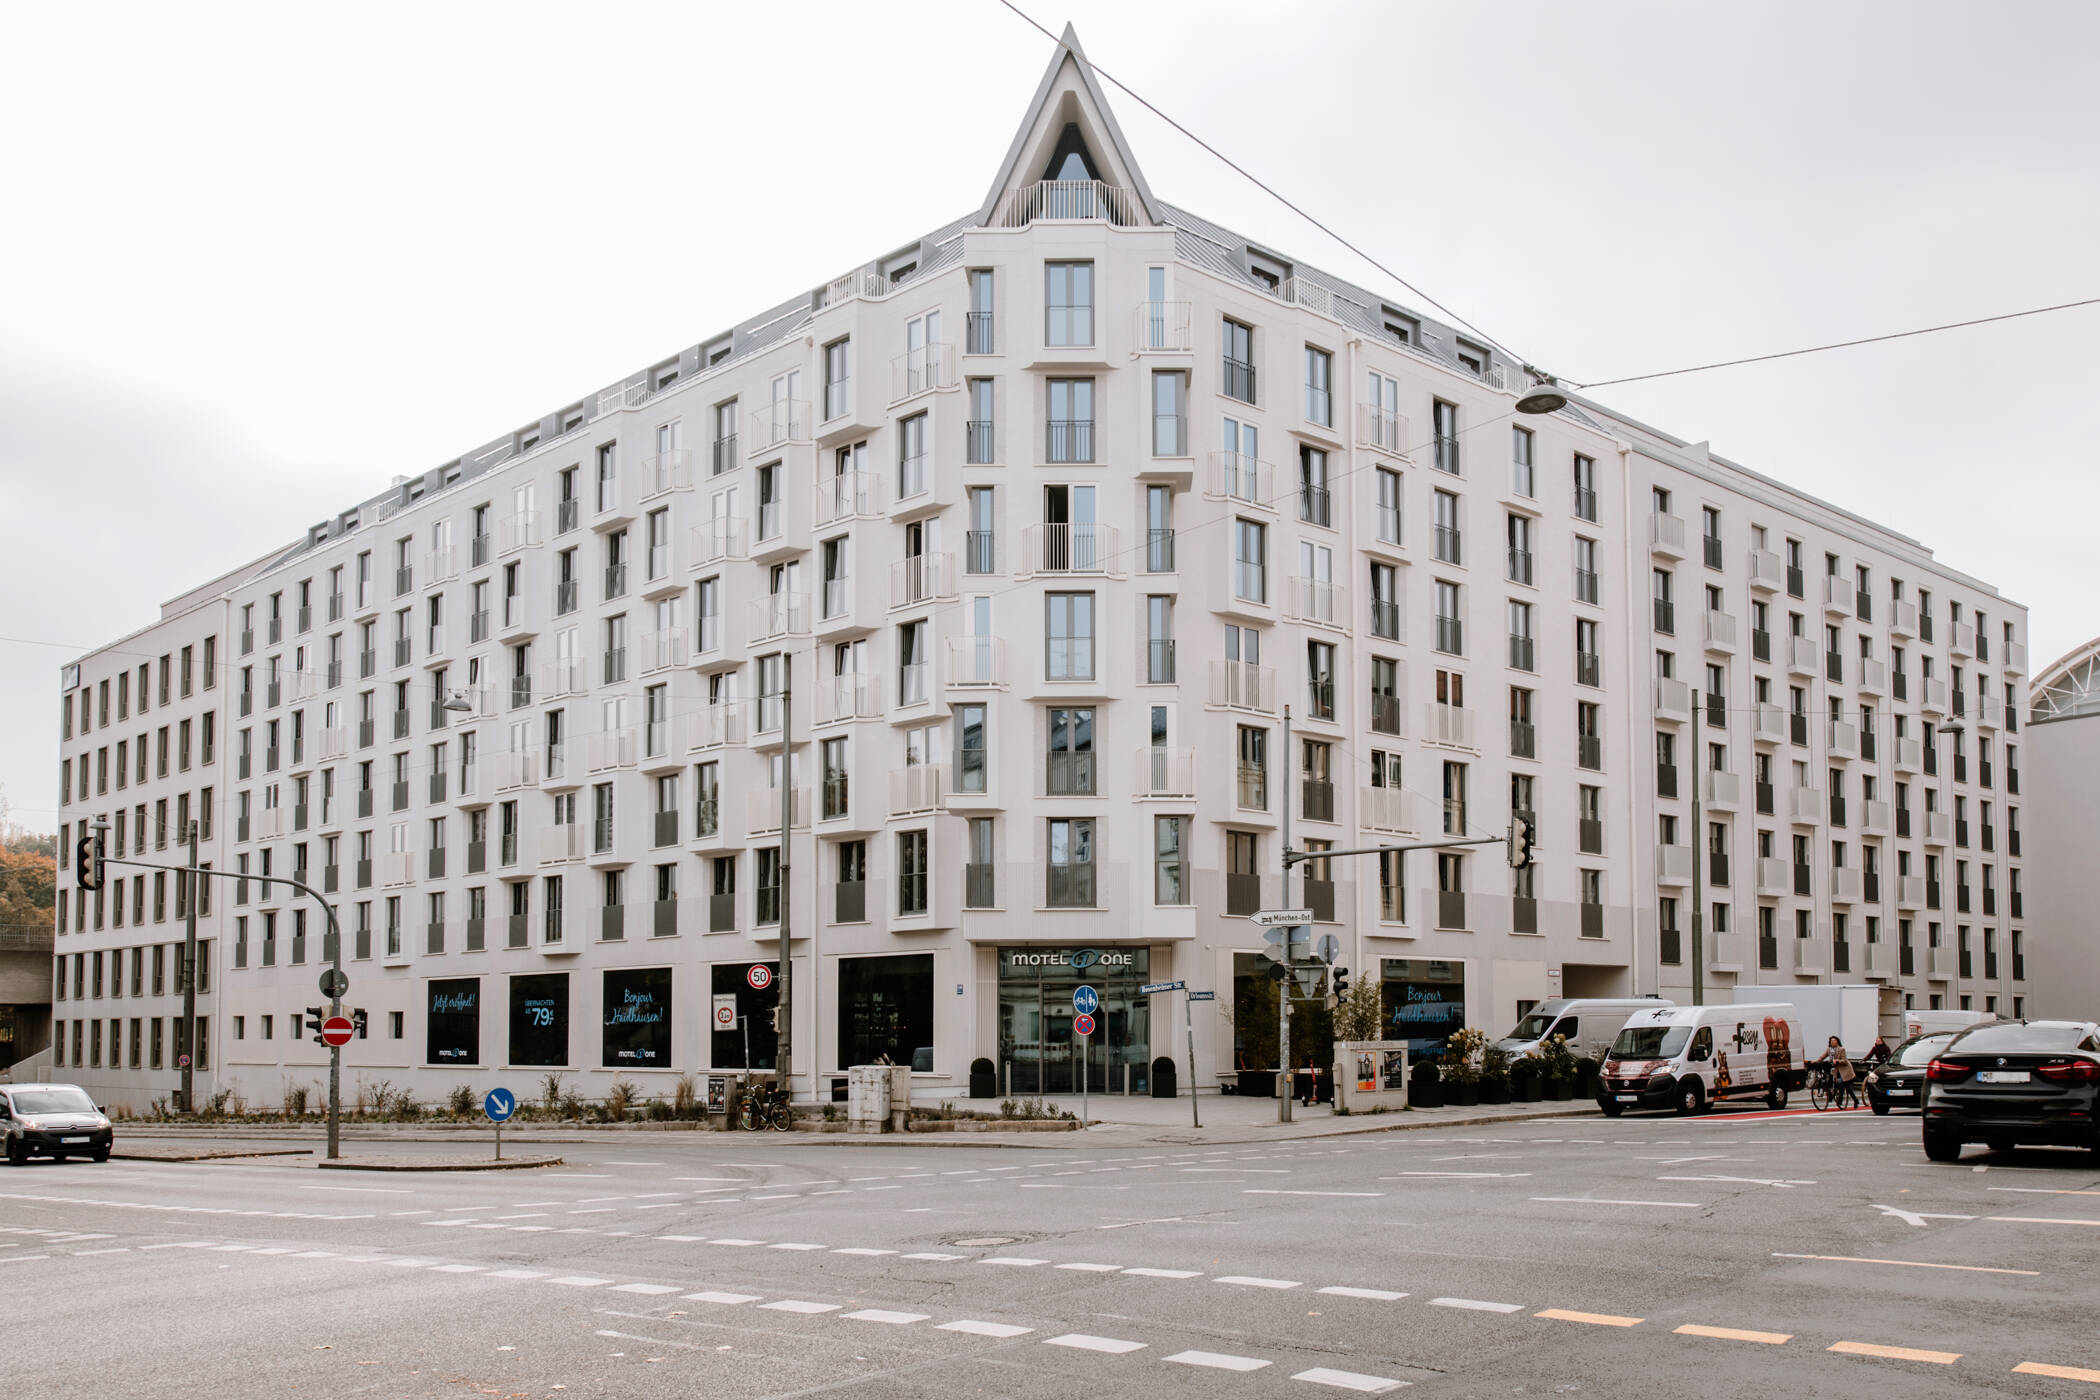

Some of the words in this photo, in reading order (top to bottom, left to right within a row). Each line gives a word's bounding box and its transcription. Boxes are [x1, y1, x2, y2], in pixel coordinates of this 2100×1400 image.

[1012, 954, 1069, 966] MOTEL
[1101, 954, 1132, 965] ONE
[753, 971, 767, 982] 50
[624, 987, 654, 1008] Bonjour
[1408, 985, 1442, 1007] Bonjour
